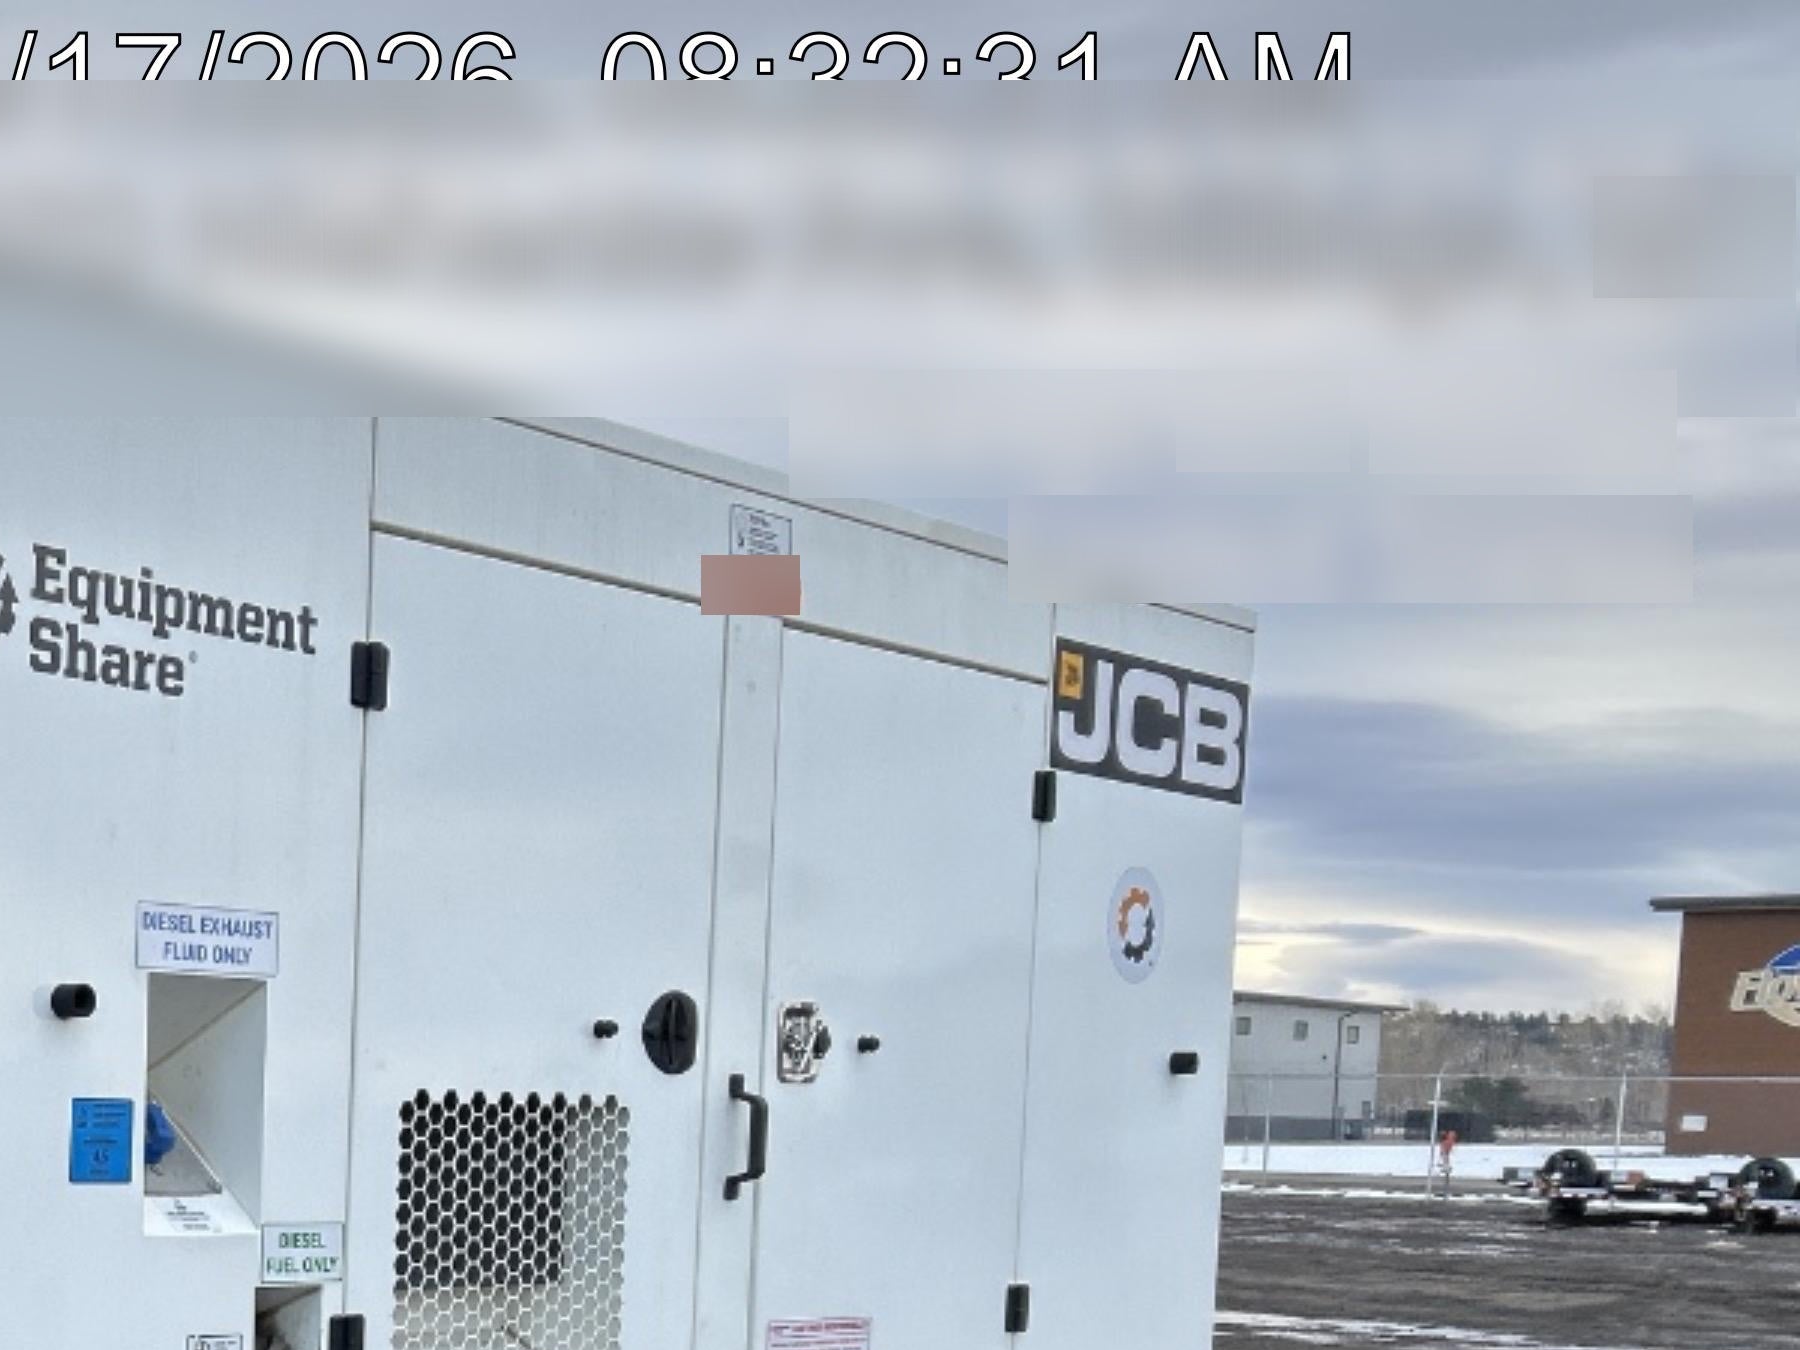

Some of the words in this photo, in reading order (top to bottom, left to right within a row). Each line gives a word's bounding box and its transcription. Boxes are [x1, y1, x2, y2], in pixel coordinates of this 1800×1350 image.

[30, 543, 318, 655] Equipment
[1057, 658, 1243, 791] JCB
[142, 911, 196, 934] DIESEL
[199, 916, 273, 940] EXHAUST
[163, 941, 207, 963] FLUID
[213, 946, 254, 965] ONLY
[278, 1232, 326, 1249] DIESEL
[266, 1257, 301, 1273] FUEL
[302, 1256, 339, 1273] ONLY
